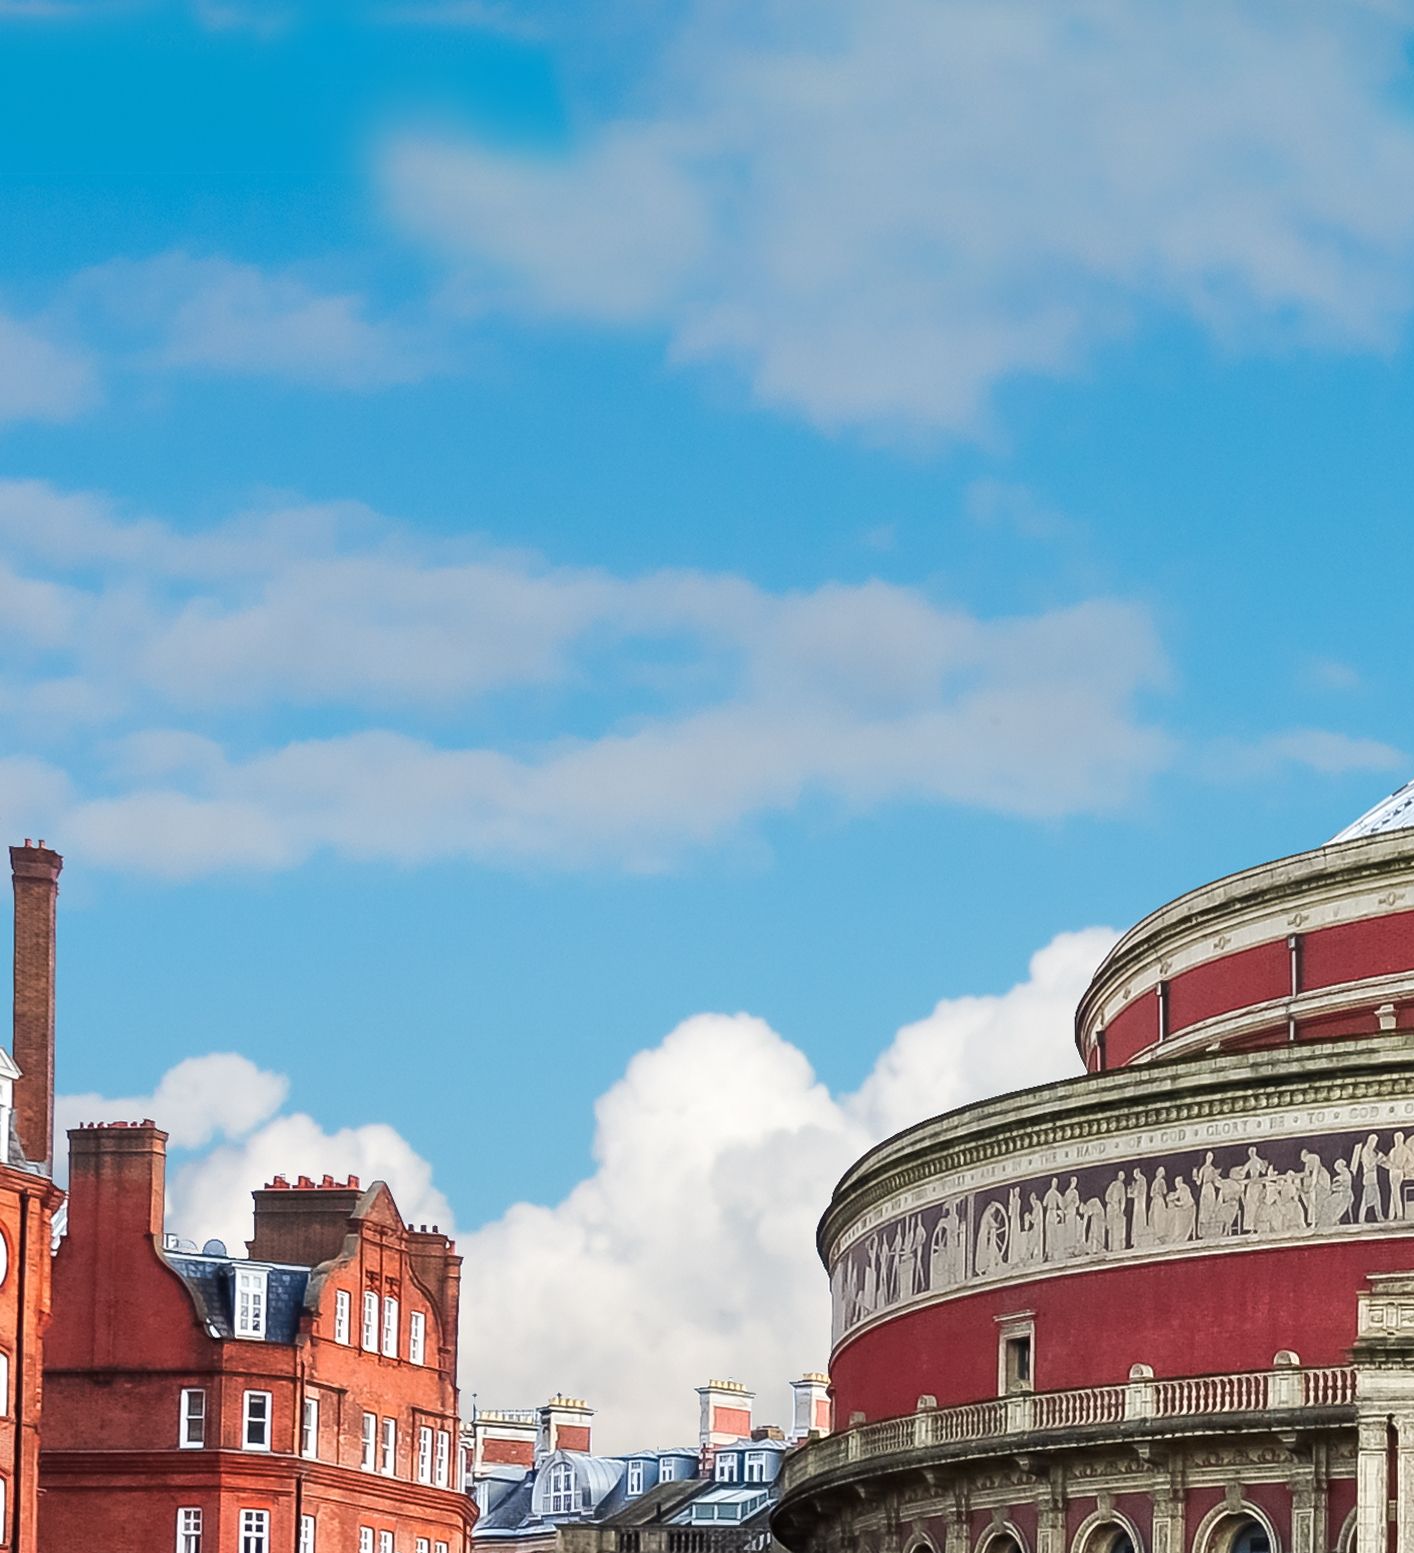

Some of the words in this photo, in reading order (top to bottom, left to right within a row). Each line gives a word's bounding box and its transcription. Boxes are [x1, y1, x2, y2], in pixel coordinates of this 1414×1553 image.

[1076, 1143, 1107, 1158] HAND
[1128, 1136, 1142, 1149] OF
[1160, 1129, 1187, 1144] GOD
[1206, 1119, 1249, 1136] GLORY
[1306, 1111, 1325, 1124] TO
[1349, 1105, 1380, 1120] GOD
